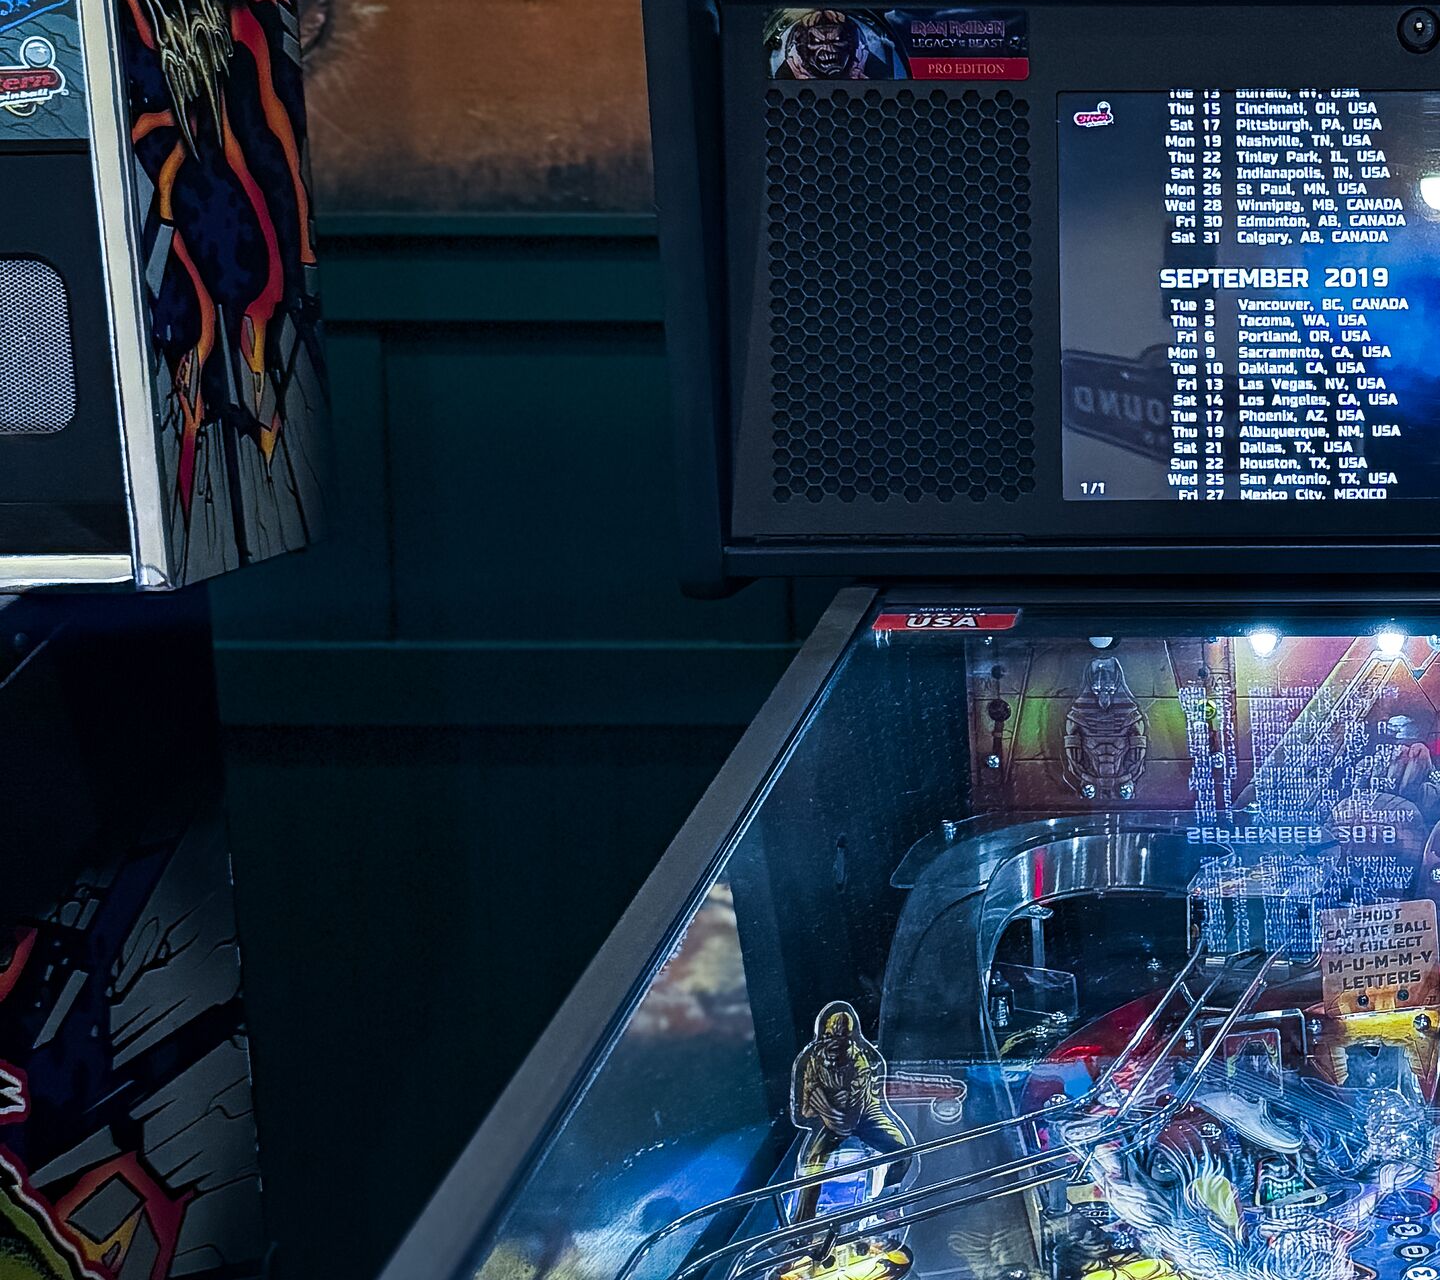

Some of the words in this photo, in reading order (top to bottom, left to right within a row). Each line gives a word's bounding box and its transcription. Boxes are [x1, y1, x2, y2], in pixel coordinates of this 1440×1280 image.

[912, 38, 956, 48] LEGACY
[969, 38, 1004, 48] BEAST
[928, 63, 952, 74] PRO
[956, 63, 1005, 74] EDITION
[1168, 103, 1194, 115] Thu
[1203, 103, 1220, 114] 15
[1316, 103, 1339, 116] OH,
[1349, 102, 1377, 114] USA
[1168, 151, 1194, 163] Thu
[1203, 151, 1221, 163] 22
[1236, 151, 1278, 165] Tinley
[1287, 151, 1322, 164] Park,
[1331, 151, 1348, 164] IL,
[1357, 151, 1386, 162] USA
[1171, 168, 1194, 179] Sat
[1203, 168, 1221, 179] 24
[1334, 167, 1352, 180] IN,
[1362, 167, 1390, 178] USA
[1166, 183, 1195, 195] Mon
[1203, 184, 1221, 195] 26
[1237, 184, 1252, 195] St
[1261, 183, 1295, 197] Paul,
[1304, 183, 1329, 196] MN,
[1338, 182, 1367, 194] USA
[1172, 232, 1195, 243] Sat
[1204, 232, 1219, 243] 31
[1238, 231, 1292, 245] Calgary,
[1300, 231, 1324, 244] AB,
[1332, 231, 1388, 243] CANADA
[1160, 268, 1309, 288] SEPTEMBER
[1325, 267, 1388, 287] 2019
[1171, 299, 1197, 311] Tue
[1205, 299, 1214, 310] 3
[1323, 299, 1344, 312] BC,
[1353, 298, 1408, 310] CANADA
[1171, 315, 1197, 327] Thu
[1205, 315, 1214, 326] 5
[1238, 314, 1294, 328] Tacoma,
[1303, 315, 1329, 328] WA,
[1338, 315, 1367, 325] USA
[1171, 411, 1197, 422] Tue
[1206, 410, 1223, 422] 17
[1240, 410, 1297, 423] Phoenix,
[1306, 410, 1327, 423] AZ,
[1336, 409, 1365, 421] USA
[1168, 474, 1198, 485] Wed
[1206, 474, 1224, 485] 25
[1240, 474, 1266, 485] San
[1274, 473, 1330, 486] Antonio,
[1339, 473, 1360, 486] TX,
[1369, 473, 1398, 484] USA
[1080, 482, 1105, 495] 1/1
[907, 615, 977, 628] USA
[1393, 920, 1432, 934] BALL
[1328, 950, 1432, 974] M-U-M-M-Y
[1343, 969, 1421, 990] LETTERS
